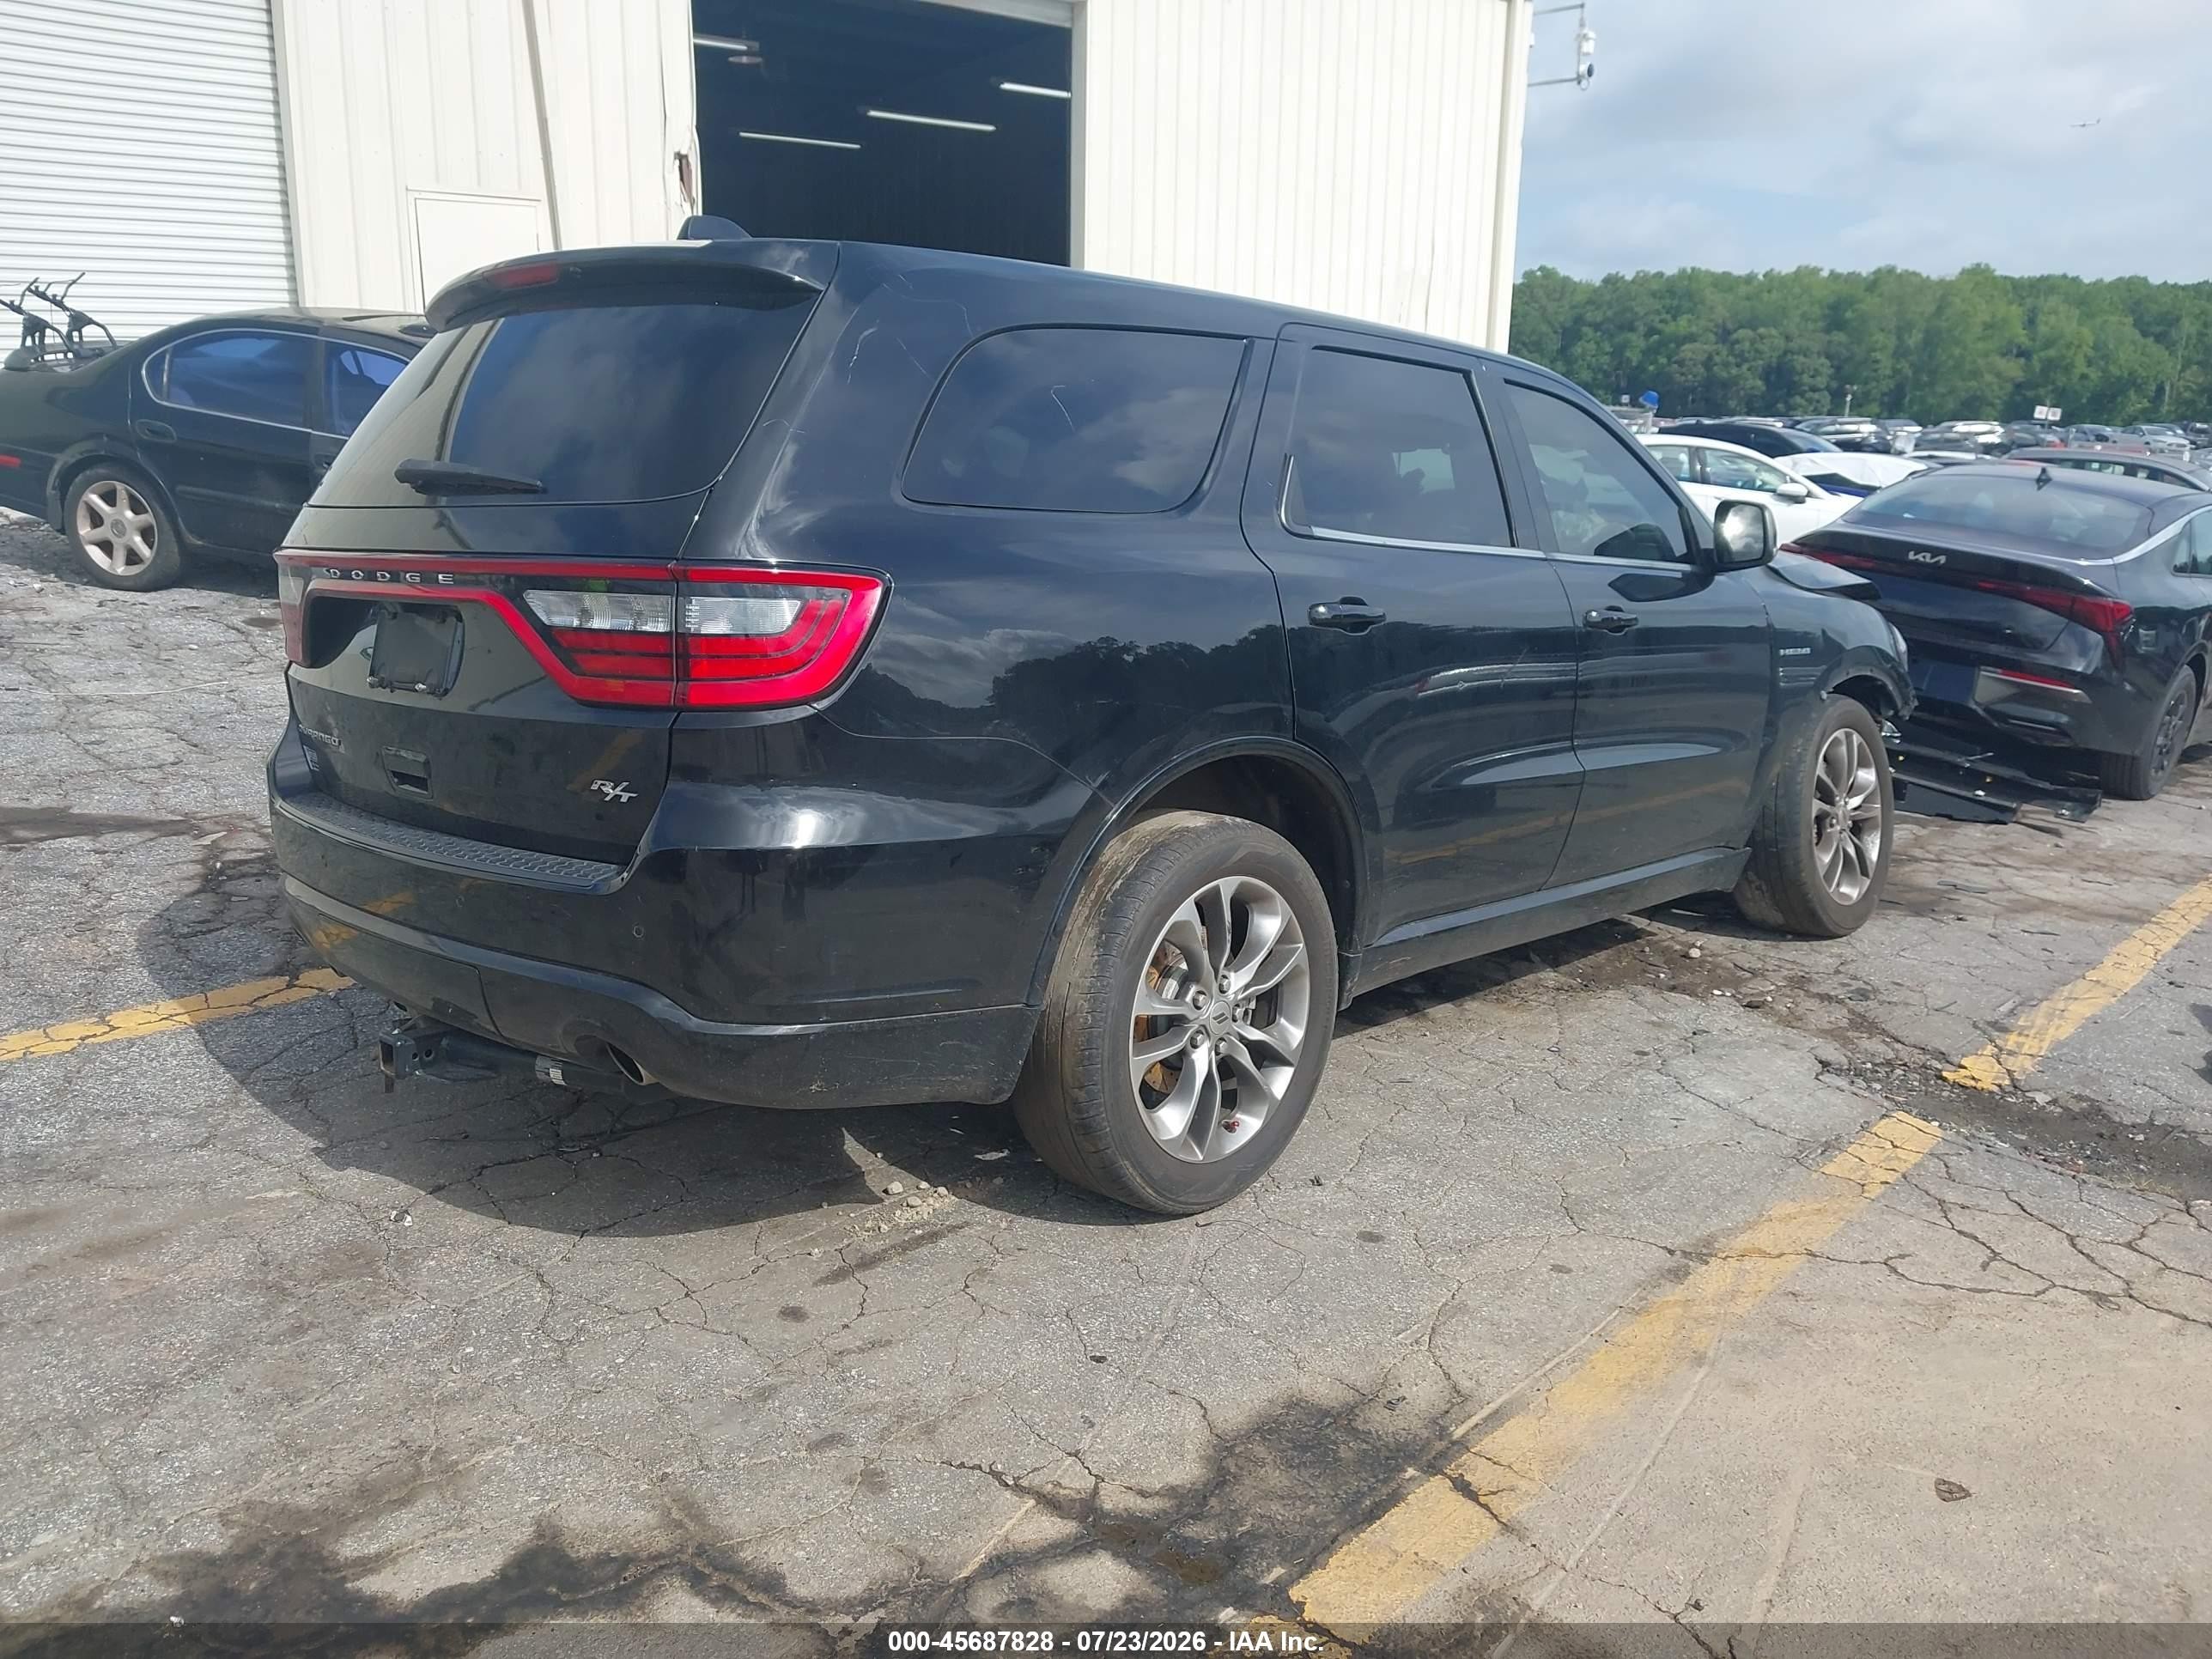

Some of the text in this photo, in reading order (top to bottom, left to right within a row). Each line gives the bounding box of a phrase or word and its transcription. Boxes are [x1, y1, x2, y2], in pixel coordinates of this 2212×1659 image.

[1909, 550, 1947, 563] KIA
[329, 568, 454, 585] DODGE
[590, 780, 639, 803] R/T
